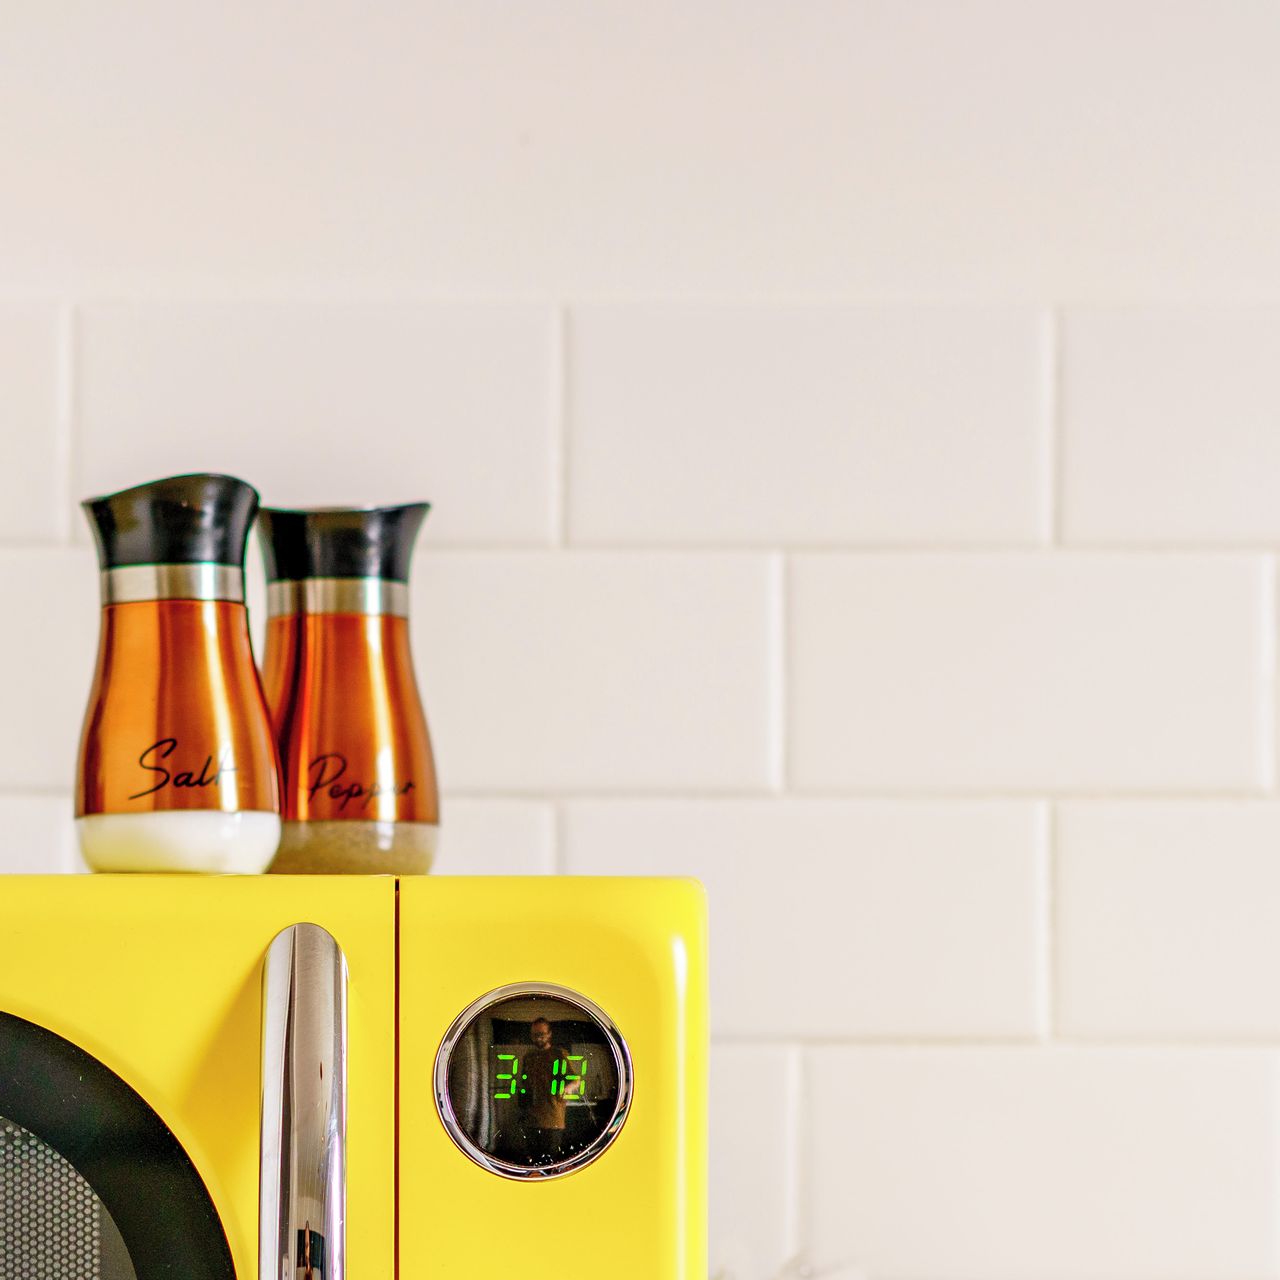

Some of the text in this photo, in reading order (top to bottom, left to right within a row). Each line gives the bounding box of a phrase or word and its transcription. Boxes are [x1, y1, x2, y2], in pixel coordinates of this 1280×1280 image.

[127, 738, 239, 800] Salt
[307, 752, 416, 811] Peppr
[493, 1054, 588, 1100] 3:18
